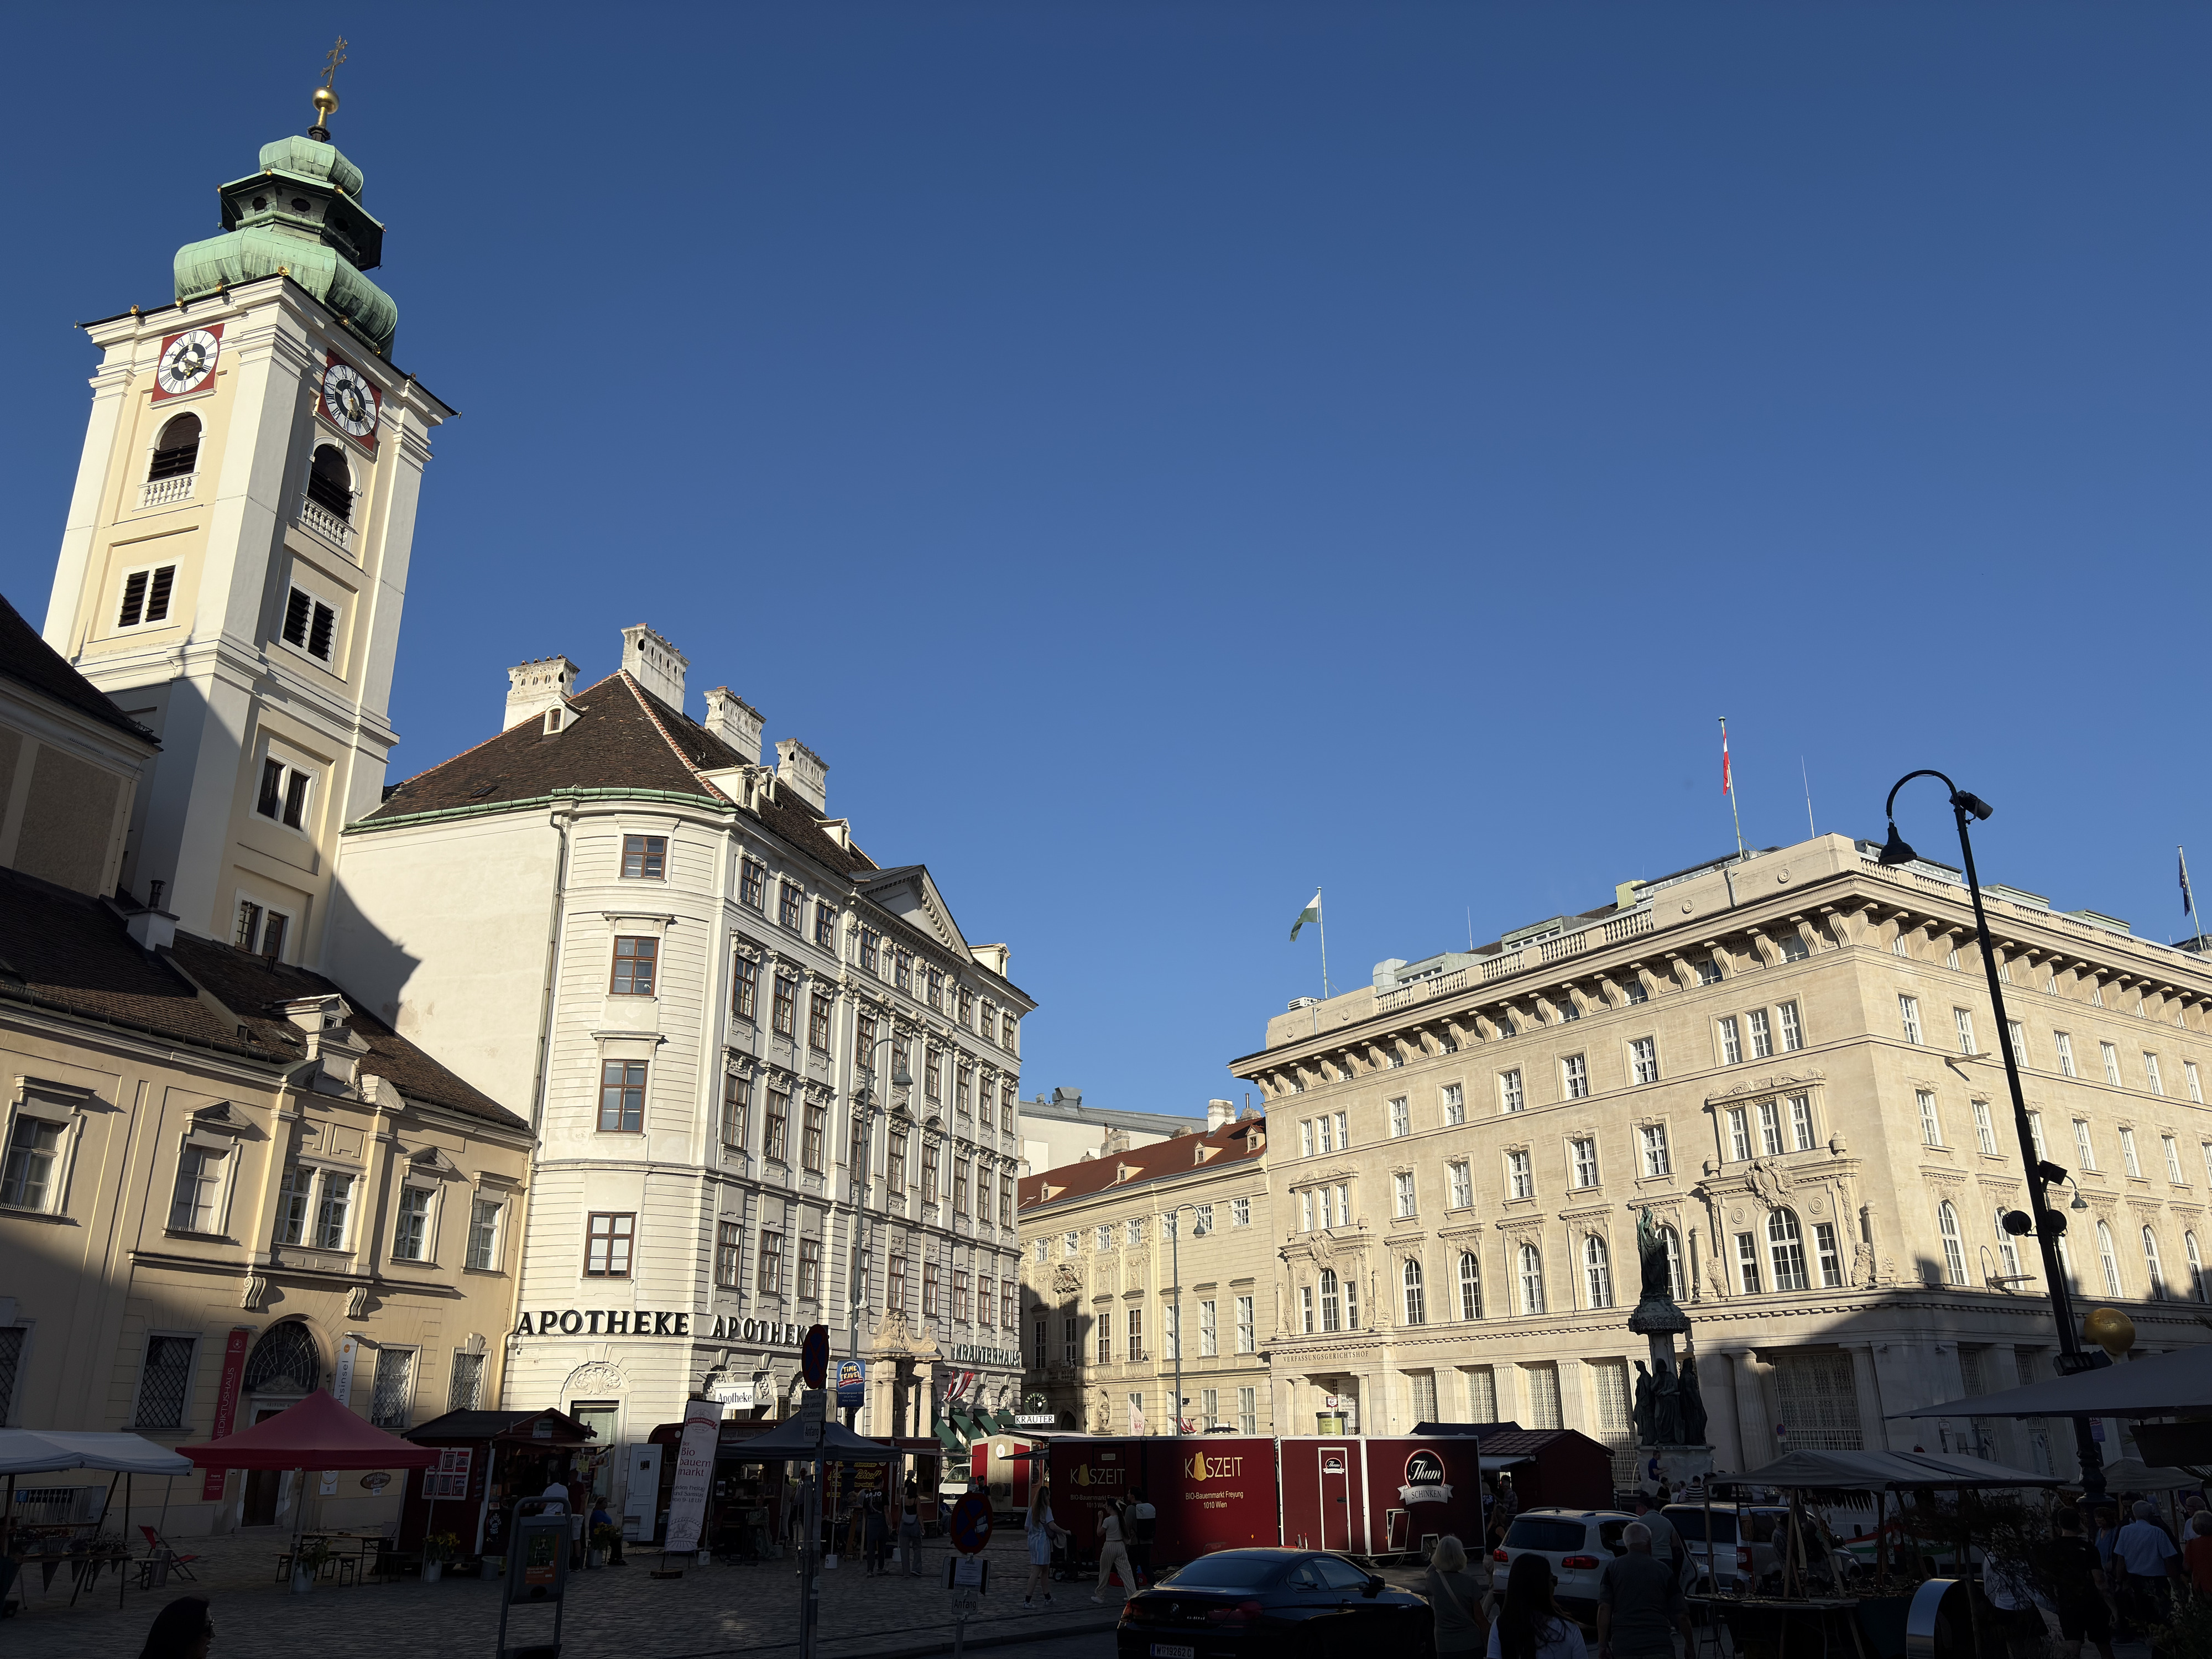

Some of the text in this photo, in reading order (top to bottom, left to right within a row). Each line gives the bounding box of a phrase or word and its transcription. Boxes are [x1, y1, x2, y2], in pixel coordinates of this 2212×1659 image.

[516, 1310, 690, 1335] APOTHEKE
[709, 1314, 811, 1345] APOTHEK
[1283, 1351, 1369, 1362] VERFASSUNGSGERICHTSHOF
[841, 1371, 860, 1380] TRAVEL
[718, 1392, 752, 1404] Apotheke
[805, 1426, 819, 1439] Anfang
[681, 1447, 695, 1456] Bio
[680, 1458, 711, 1467] bauern
[678, 1468, 705, 1477] markt
[1408, 1459, 1441, 1480] Thum
[1185, 1491, 1244, 1500] BIO-Bauernmarkt Freyung
[1411, 1490, 1442, 1499] SCHINKEN
[954, 1599, 976, 1610] Anfang
